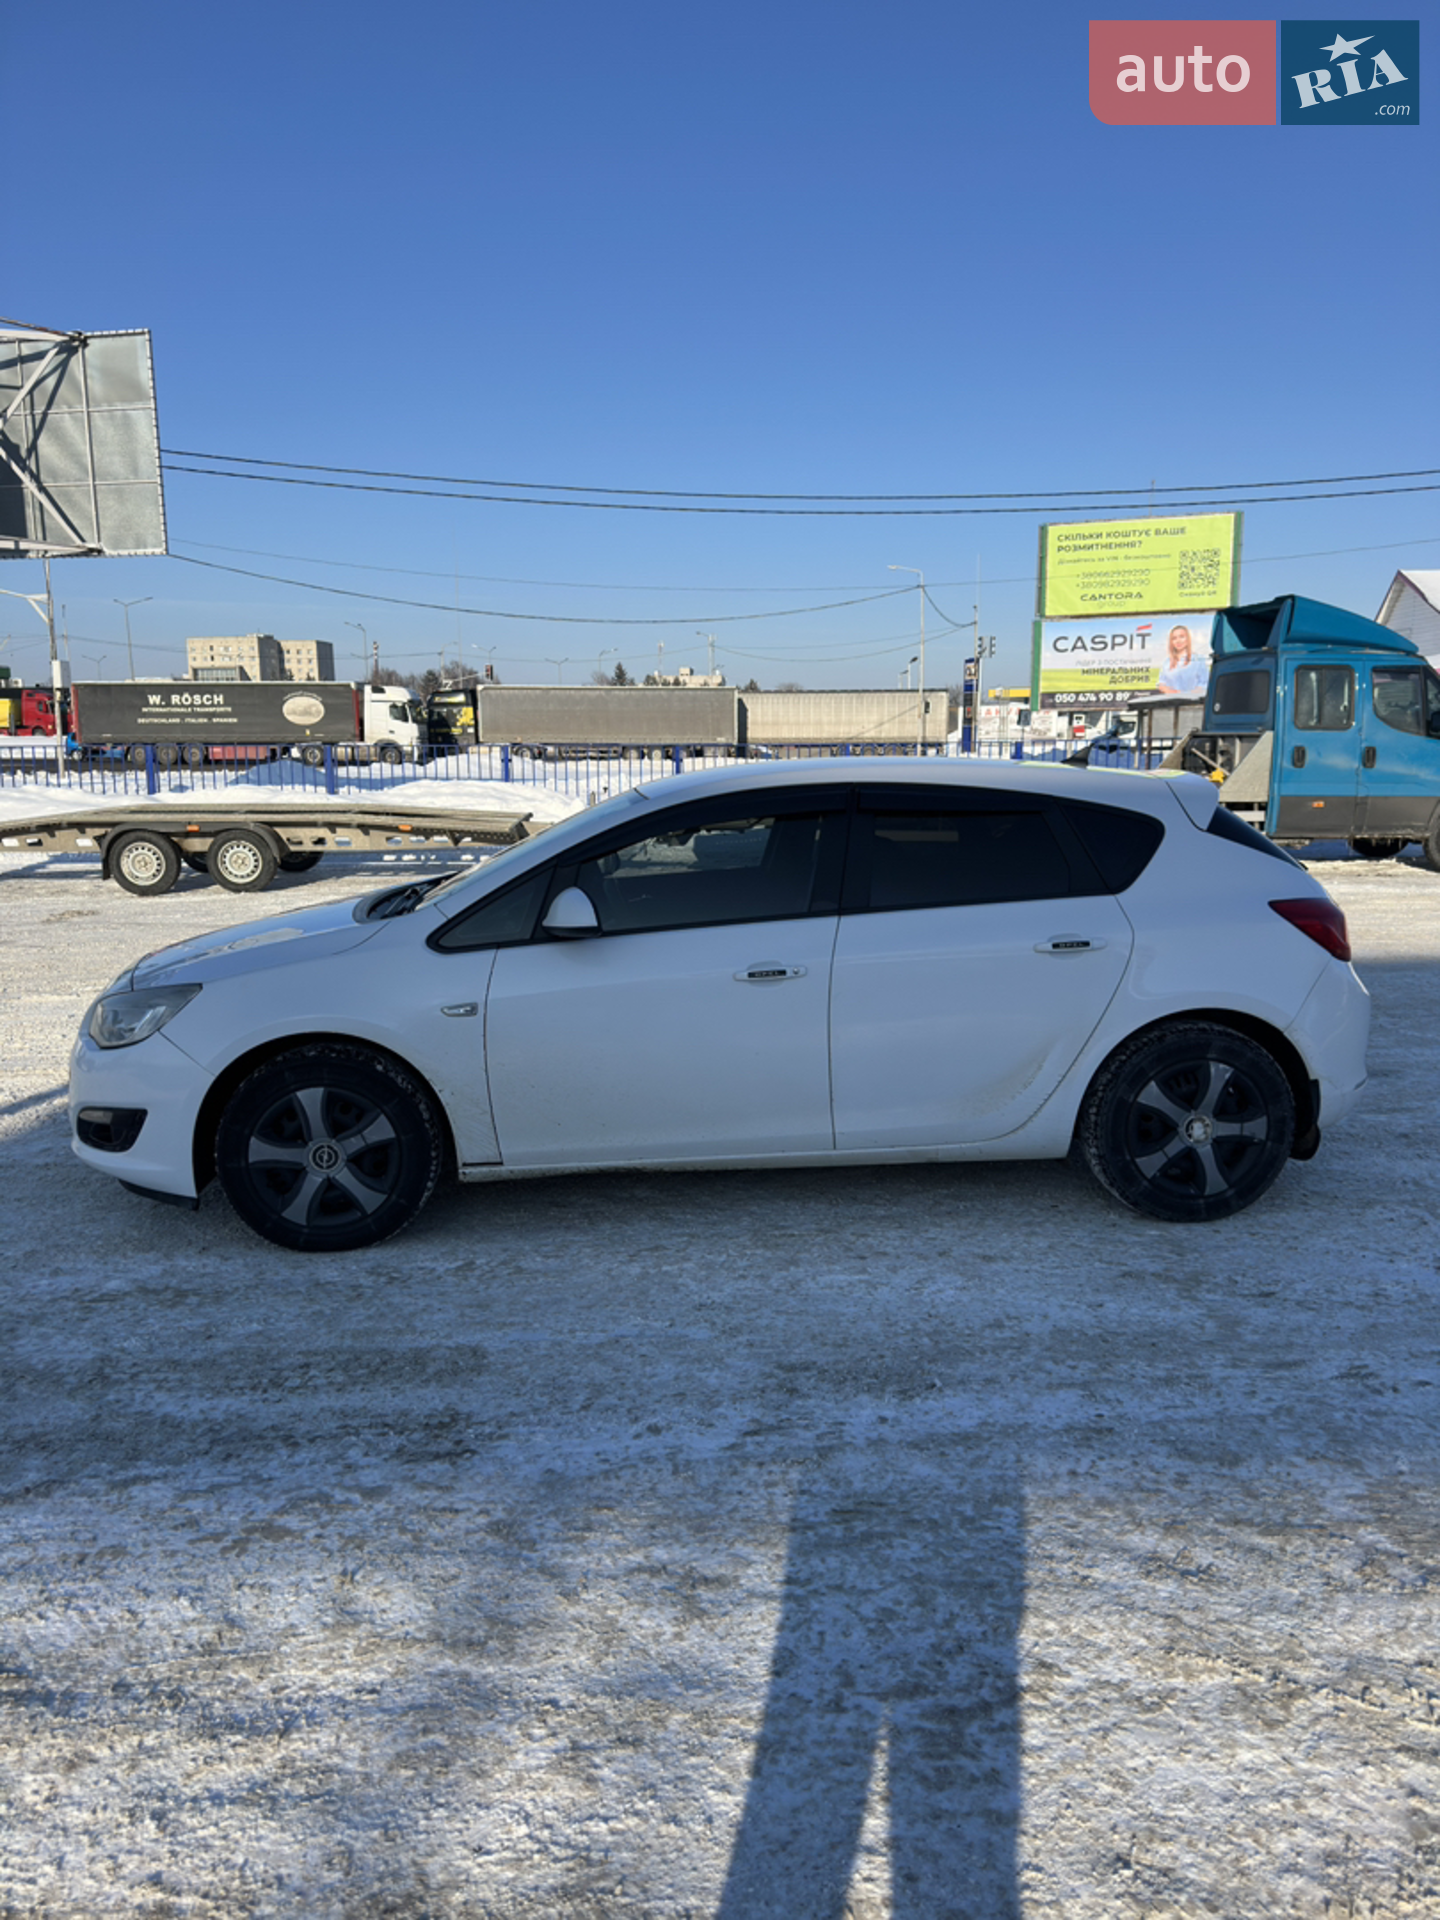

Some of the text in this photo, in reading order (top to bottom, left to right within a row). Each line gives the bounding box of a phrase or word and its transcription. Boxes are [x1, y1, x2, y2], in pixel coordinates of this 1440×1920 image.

[1057, 526, 1187, 543] СКІЛЬКИ КОШТУЄ ВАШЕ
[1056, 540, 1143, 553] РОЗМИТНЕННЯ?
[1080, 592, 1143, 602] CANTORA
[1052, 632, 1152, 653] CASPIT
[1081, 666, 1151, 676] МІНЕРАЛЬНИХ
[1109, 675, 1151, 685] ДОБРИВ
[147, 691, 224, 706] W. RÖSCH
[1054, 693, 1076, 703] 050
[1077, 692, 1097, 703] 474
[1098, 691, 1114, 702] 90
[1115, 691, 1130, 702] 89
